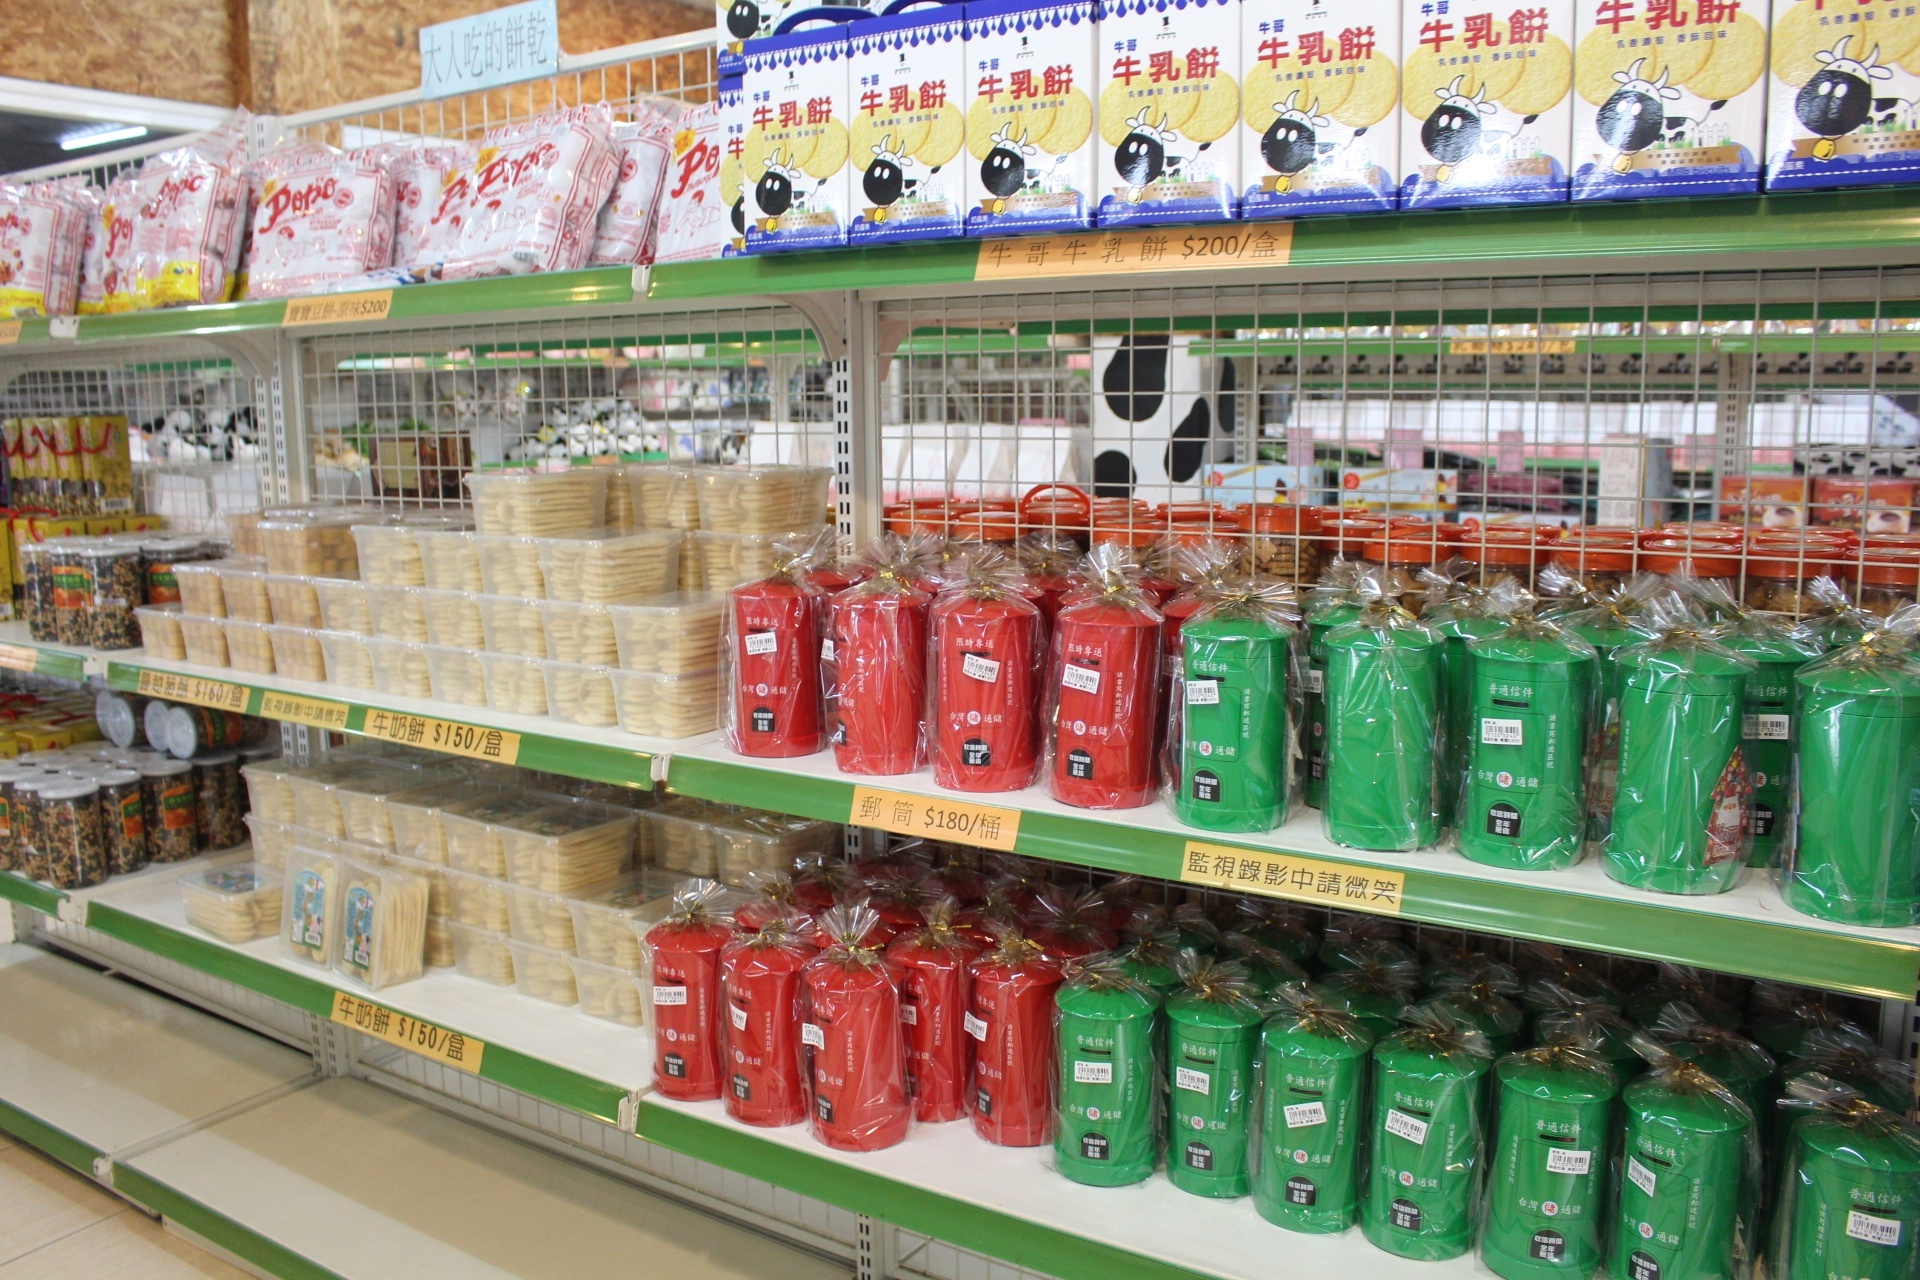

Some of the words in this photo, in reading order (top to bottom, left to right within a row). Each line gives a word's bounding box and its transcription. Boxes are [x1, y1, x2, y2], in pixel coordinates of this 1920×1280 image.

[1421, 0, 1449, 17] 牛哥
[1258, 18, 1285, 35] 牛哥
[1419, 7, 1549, 53] 牛乳餅
[424, 11, 547, 84] 大人吃的餅乾
[1114, 38, 1138, 54] 牛哥
[1257, 25, 1376, 70] 牛乳餅
[978, 58, 1000, 73] 牛哥
[1112, 45, 1220, 87] 牛乳餅
[860, 73, 879, 88] 牛哥
[977, 63, 1073, 104] 牛乳餅
[753, 91, 771, 103] 牛哥
[860, 78, 947, 117] 牛乳餅
[752, 95, 833, 131] 牛乳餅
[987, 233, 1167, 268] 牛哥牛乳餅
[1181, 230, 1280, 261] $200/盒
[745, 616, 779, 627] 限時專送
[956, 637, 995, 648] 限時專送
[1068, 643, 1103, 657] 限時專送
[1191, 660, 1229, 673] 普通信件
[1488, 682, 1534, 699] 普通信件
[372, 711, 426, 744] 牛奶餅
[433, 722, 503, 757] $150/盒
[1477, 770, 1494, 783] 台灣
[1516, 776, 1540, 788] 通儲
[860, 795, 912, 828] 郵筒
[923, 808, 1003, 840] $180/桶
[1187, 850, 1398, 904] 監視錄影中請微笑
[338, 995, 390, 1036] 牛奶餅
[397, 1017, 465, 1062] $150/盒
[1076, 1034, 1114, 1047] 普通信件
[1181, 1042, 1218, 1057] 普通信件
[1285, 1073, 1327, 1088] 普通信件
[1394, 1091, 1435, 1109] 普通信件
[1103, 1110, 1122, 1120] 通儲
[1535, 1119, 1582, 1134] 普通信件
[1636, 1135, 1677, 1159] 普通信件
[1311, 1154, 1331, 1164] 通儲
[1416, 1177, 1438, 1188] 通儲
[1518, 1197, 1539, 1211] 台灣
[1848, 1187, 1902, 1204] 普通信件
[1656, 1231, 1680, 1245] 通儲
